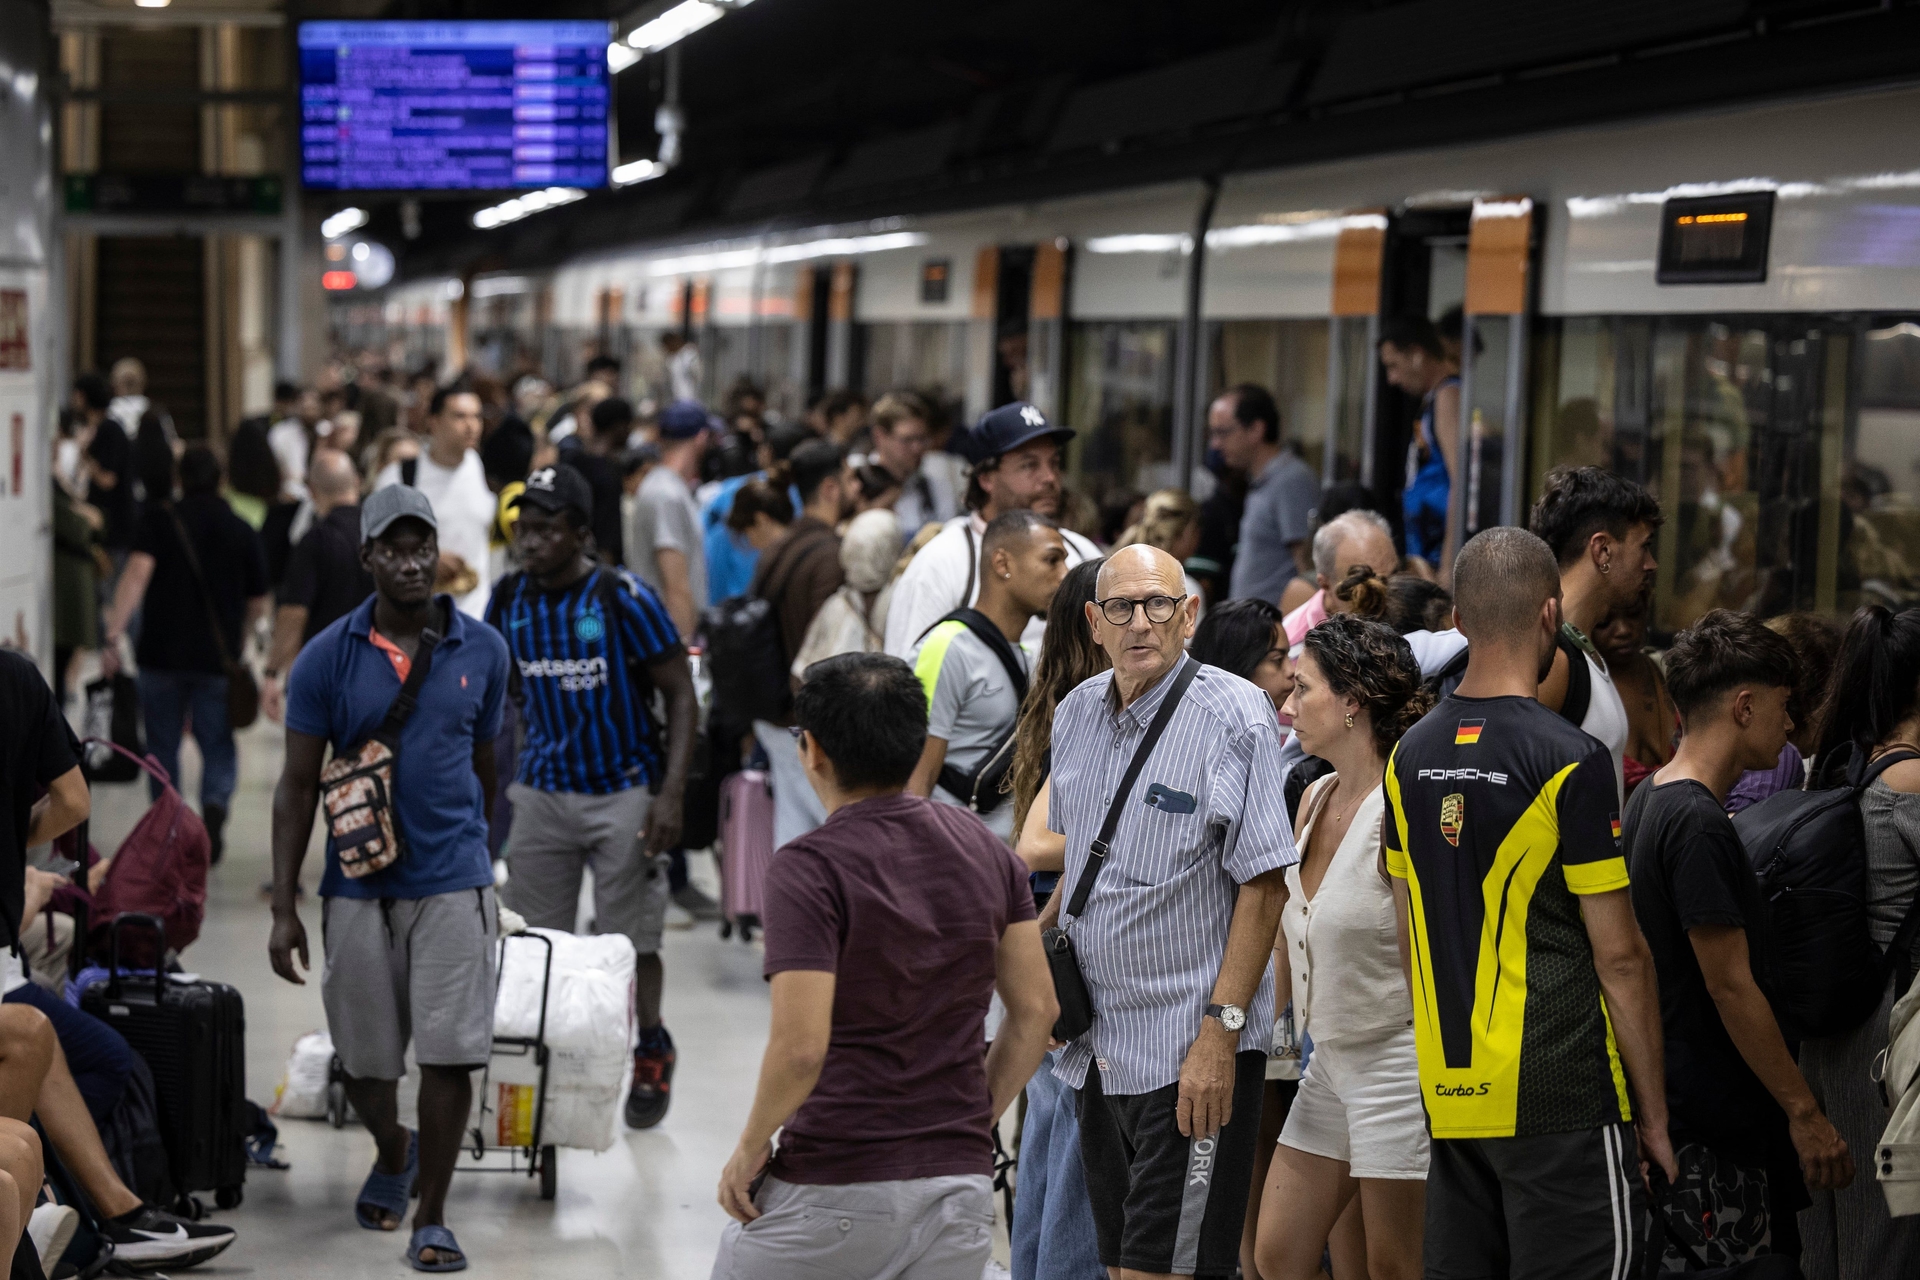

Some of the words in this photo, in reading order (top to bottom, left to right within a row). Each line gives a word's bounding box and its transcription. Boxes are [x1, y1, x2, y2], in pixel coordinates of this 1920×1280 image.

[516, 656, 607, 677] betsson
[1418, 768, 1508, 785] PORSCHE
[1435, 1083, 1475, 1096] turbo
[1475, 1082, 1492, 1096] S
[1189, 1134, 1215, 1186] ORK
